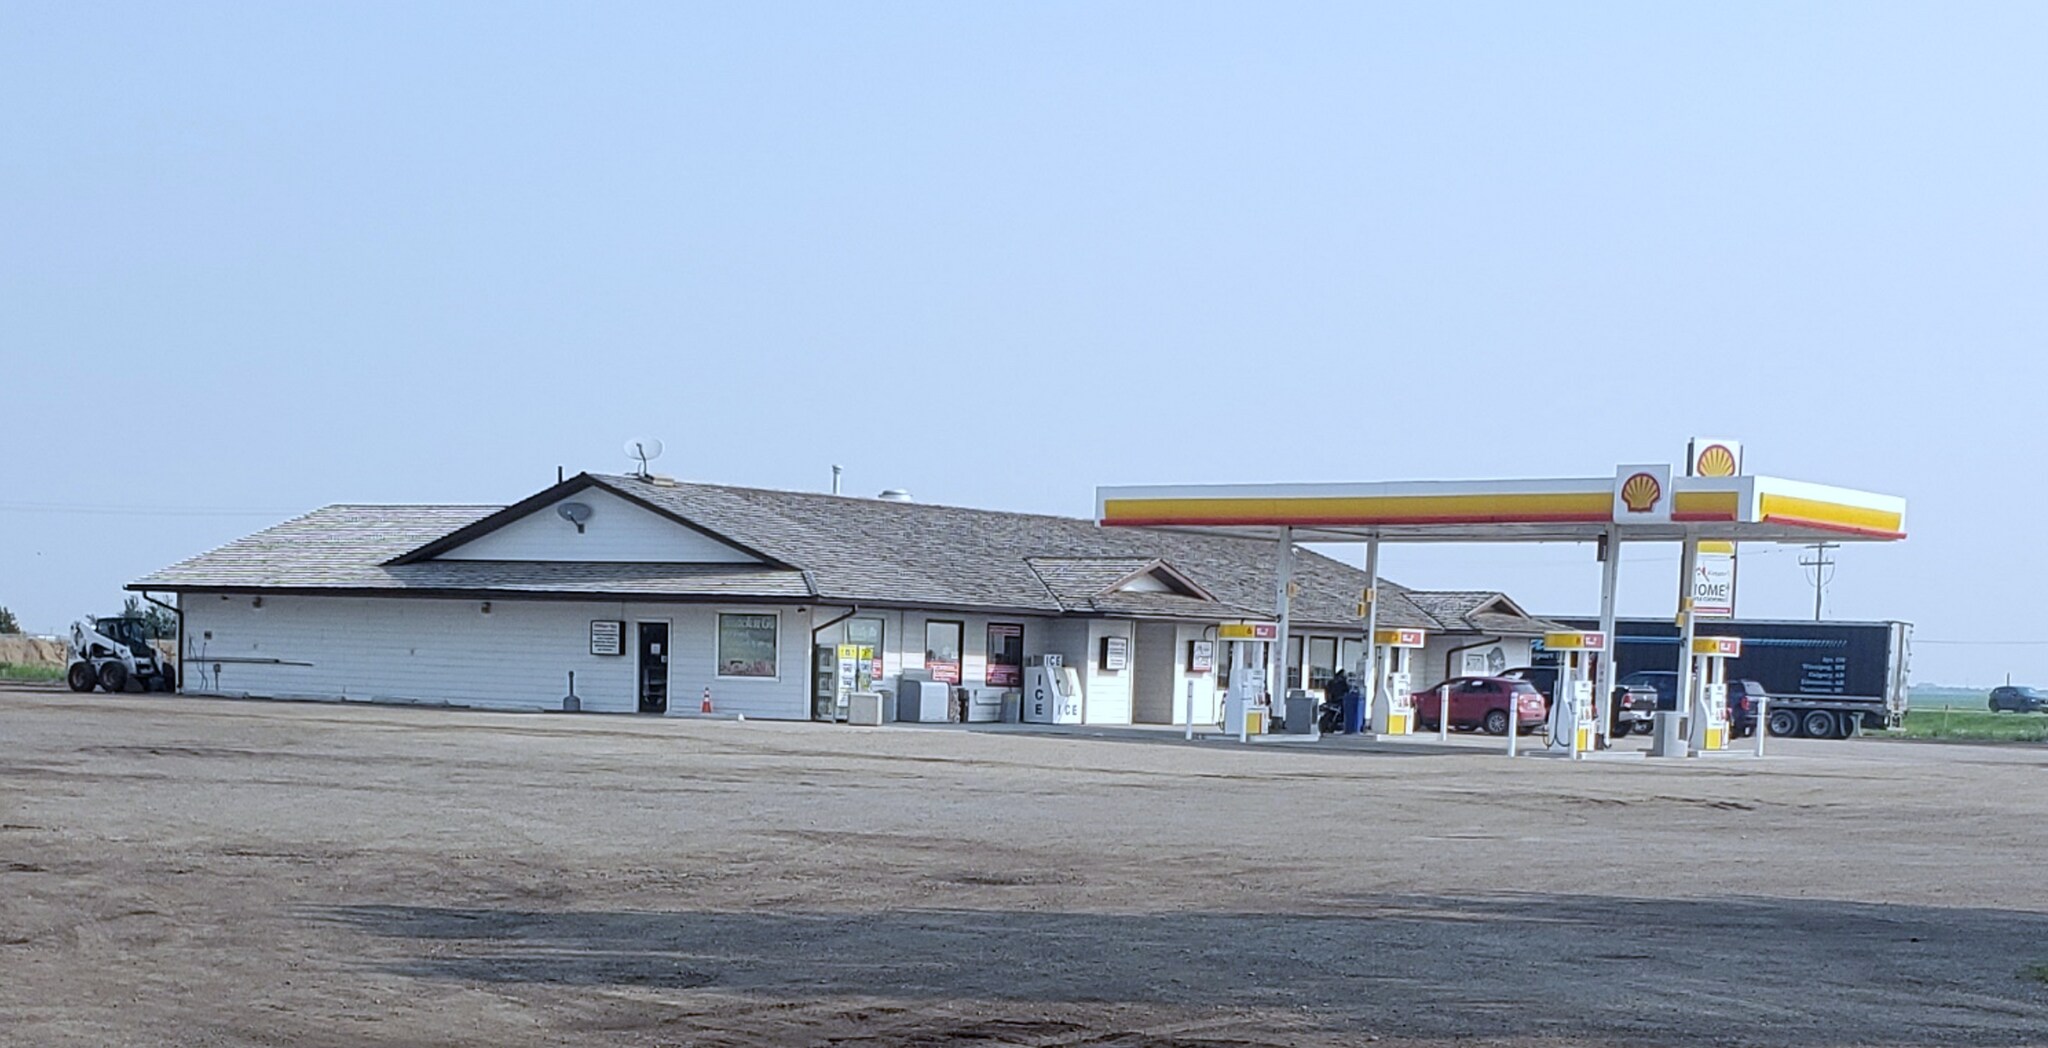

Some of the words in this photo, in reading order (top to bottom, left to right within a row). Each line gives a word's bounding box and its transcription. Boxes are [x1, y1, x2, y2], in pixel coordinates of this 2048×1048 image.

[1046, 655, 1061, 666] ICE
[1035, 674, 1044, 715] ICE
[1057, 704, 1078, 716] ICE
